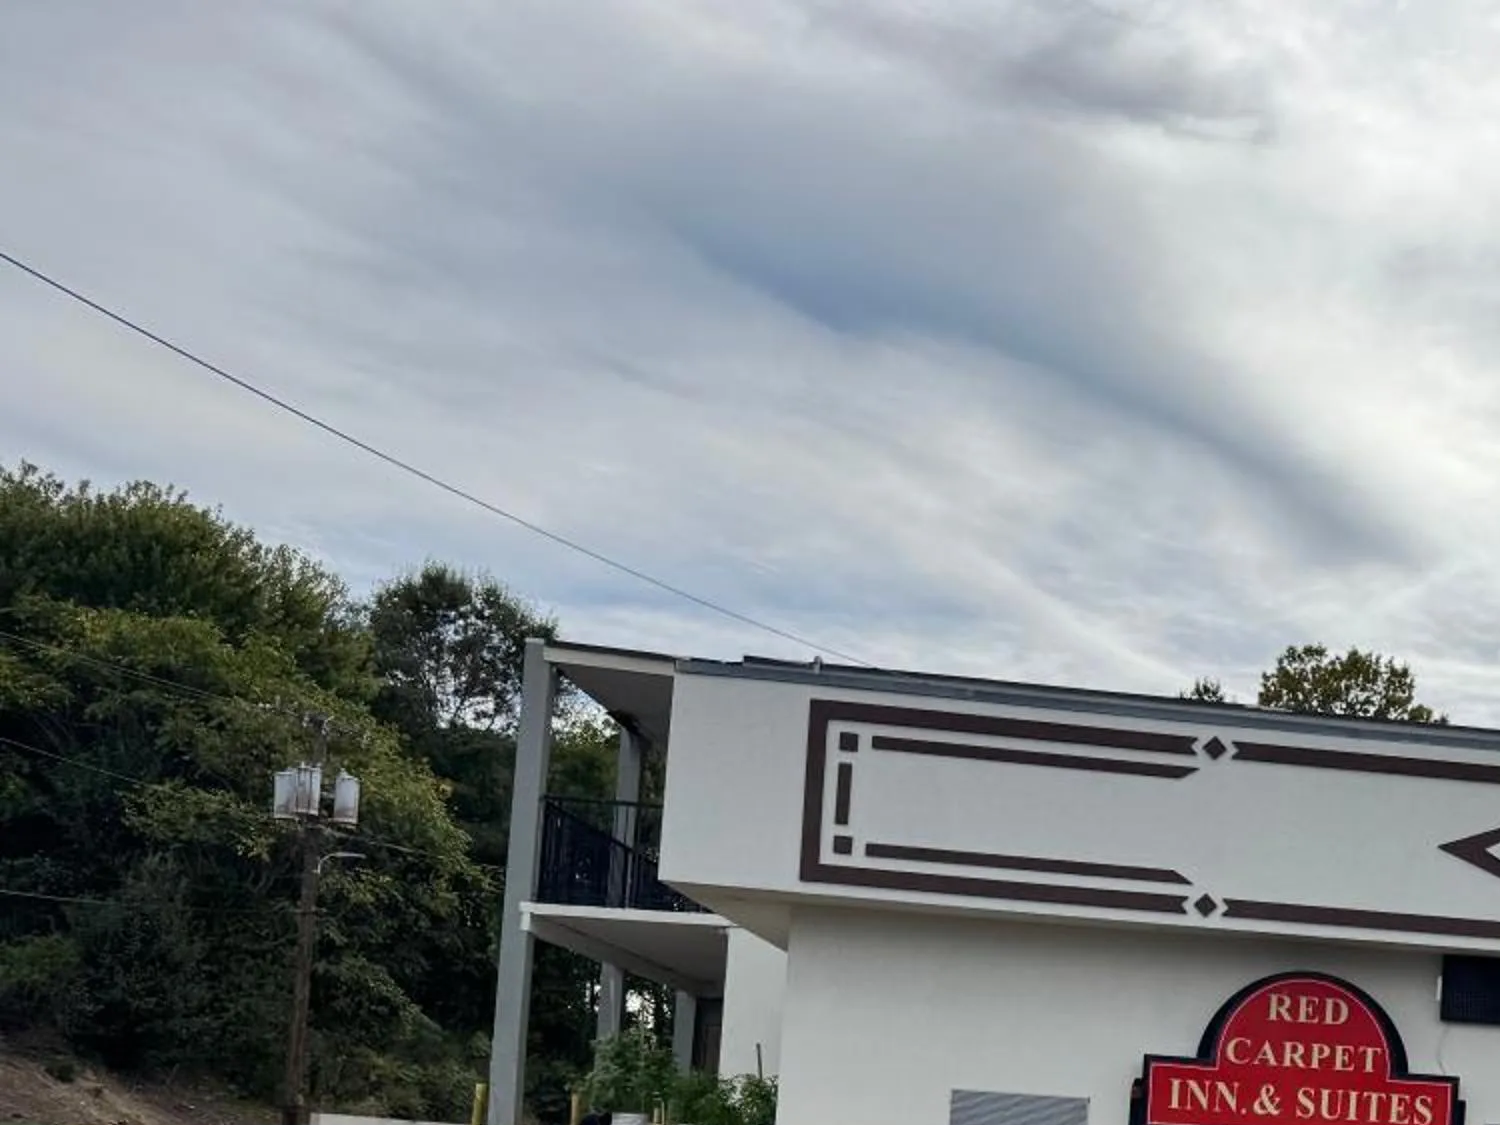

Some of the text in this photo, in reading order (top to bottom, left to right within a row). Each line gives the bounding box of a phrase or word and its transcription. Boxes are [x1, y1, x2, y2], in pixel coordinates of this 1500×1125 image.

[1267, 992, 1350, 1025] RED
[1226, 1036, 1383, 1074] CARPET
[1252, 1083, 1282, 1116] &
